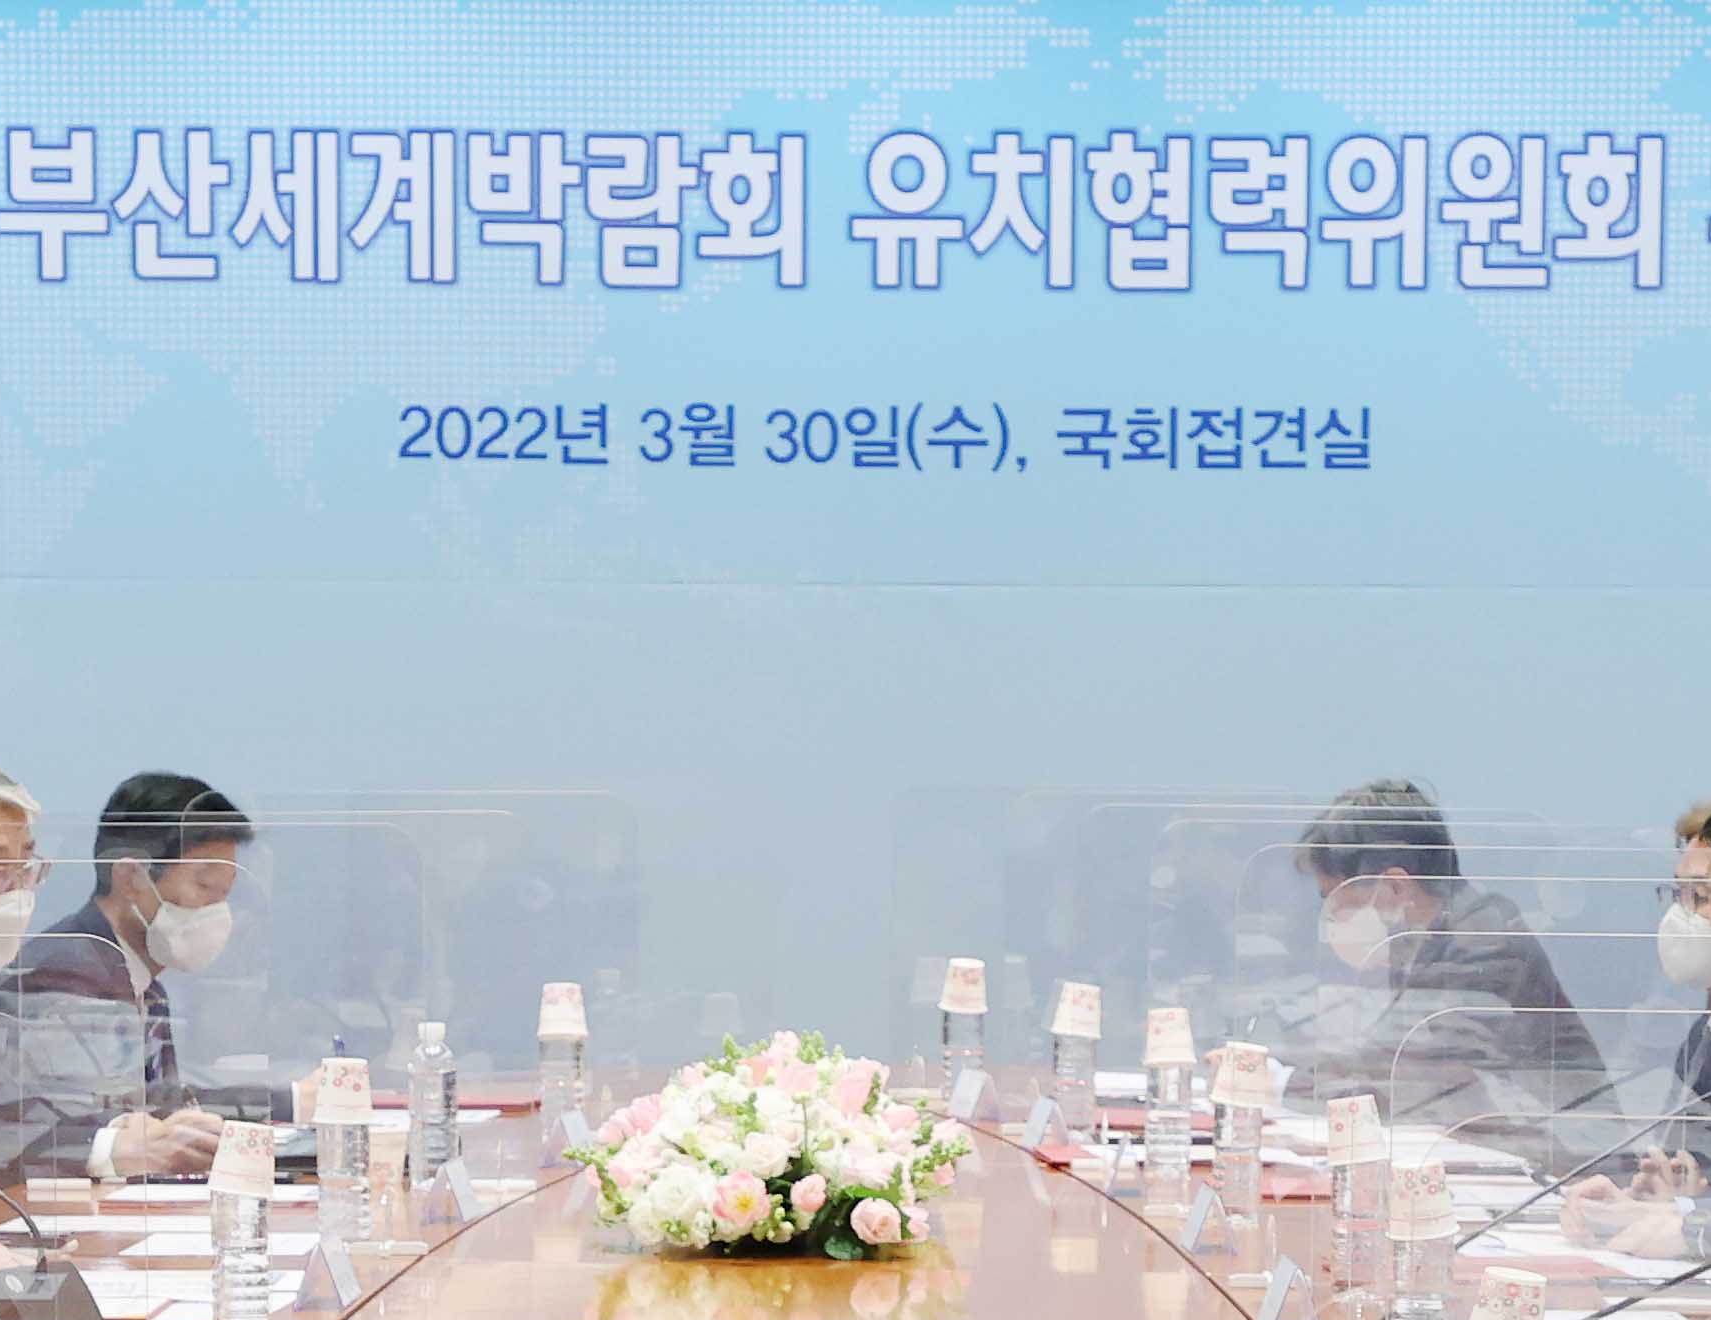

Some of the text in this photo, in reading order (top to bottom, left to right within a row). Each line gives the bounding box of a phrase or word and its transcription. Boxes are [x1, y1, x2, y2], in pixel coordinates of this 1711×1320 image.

[849, 130, 1666, 291] 유치협력위원회
[398, 402, 1373, 471] 2022년 3월 30일(수), 국회접견실
